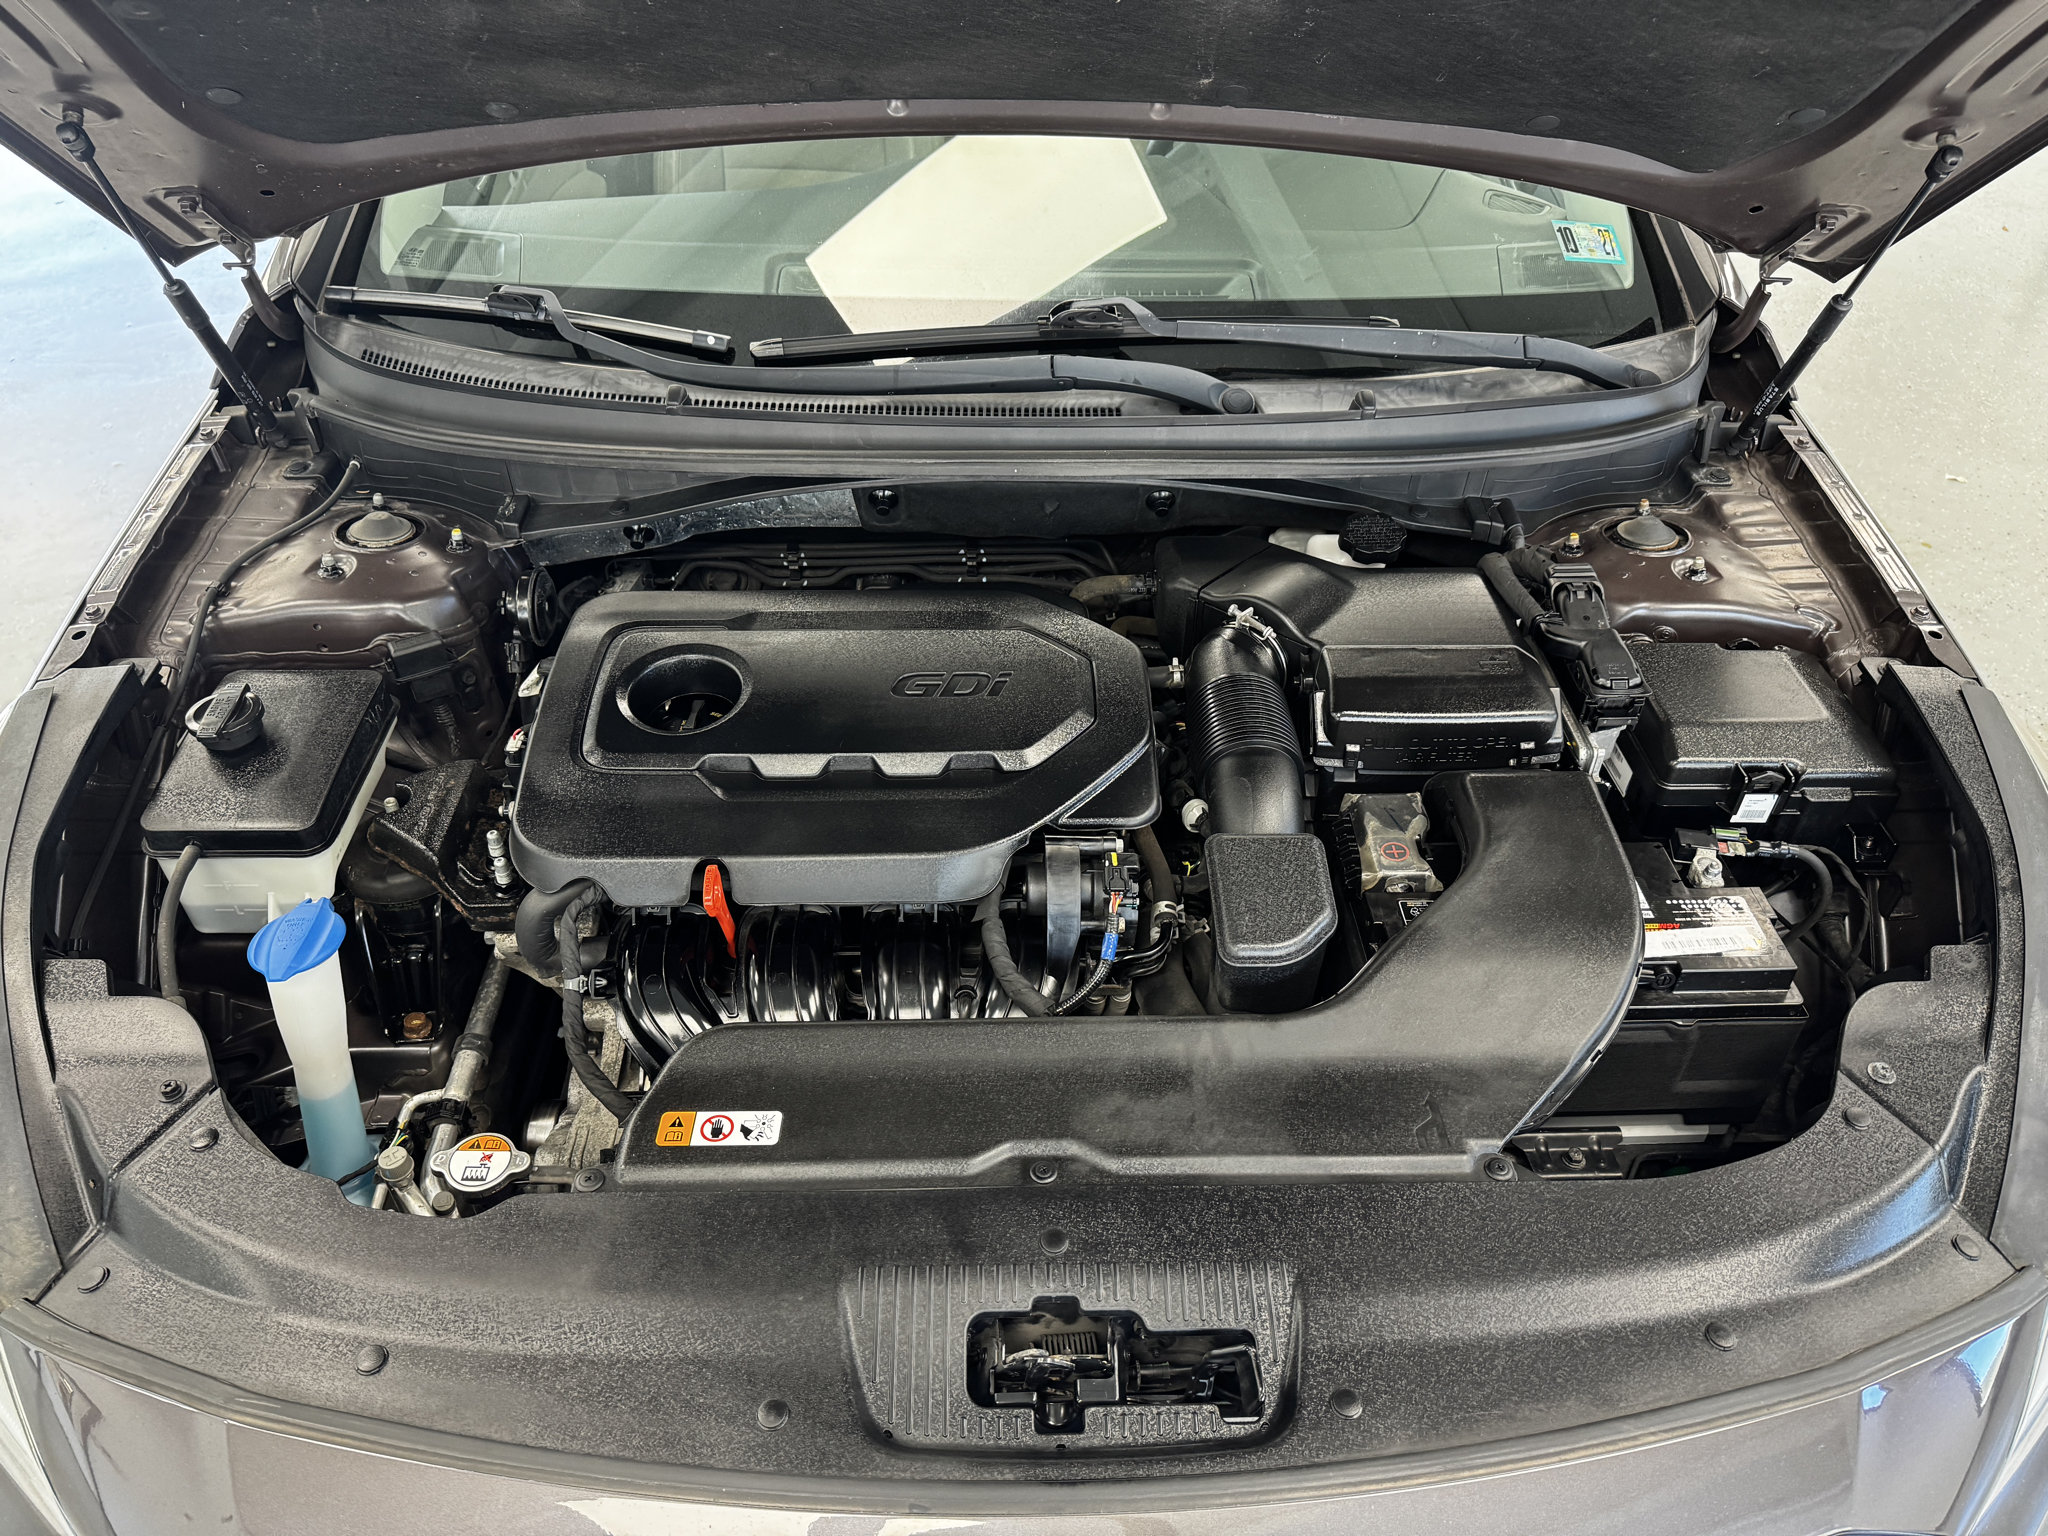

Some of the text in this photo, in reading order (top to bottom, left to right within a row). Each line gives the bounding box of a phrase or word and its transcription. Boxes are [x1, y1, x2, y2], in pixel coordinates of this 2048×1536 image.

[1556, 226, 1616, 256] 10 27
[1757, 386, 1779, 416] STABILUS
[889, 669, 1014, 698] GDi
